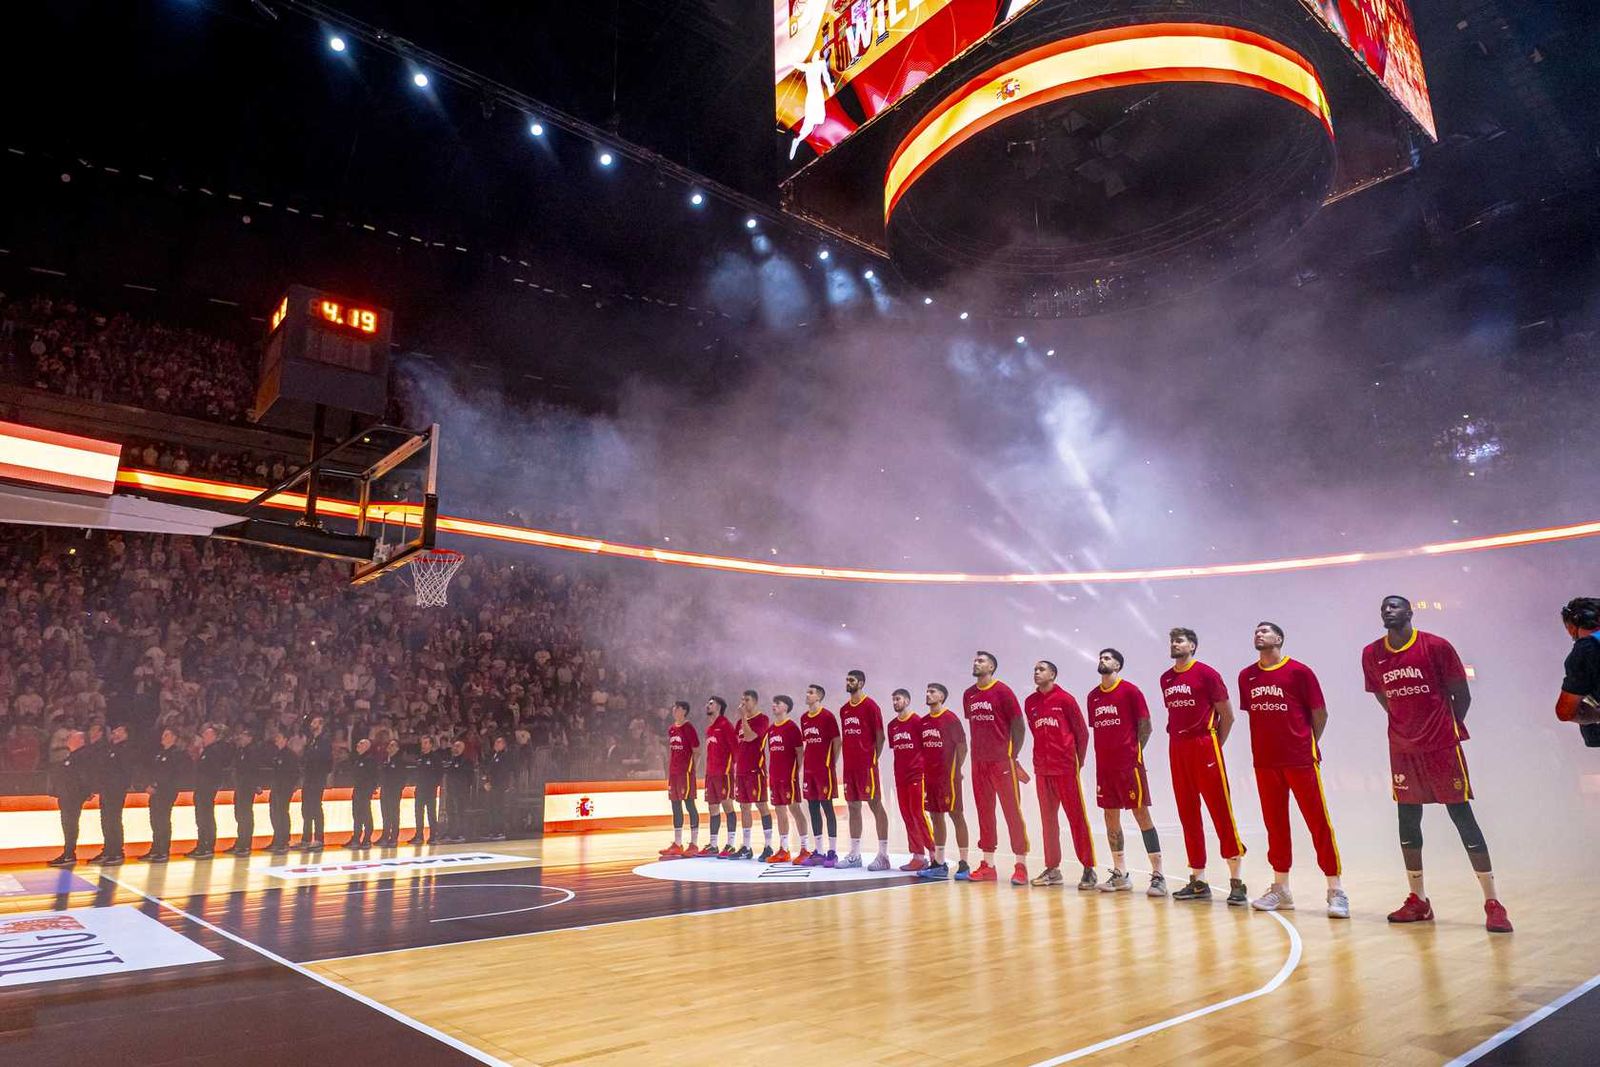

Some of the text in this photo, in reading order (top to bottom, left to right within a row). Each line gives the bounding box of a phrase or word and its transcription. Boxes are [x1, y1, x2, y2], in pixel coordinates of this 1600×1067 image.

[1382, 665, 1424, 684] ESPAÑA
[1164, 684, 1192, 698] ESPAÑA
[1250, 684, 1284, 699] ESPAÑA
[1385, 684, 1431, 698] endesa
[970, 700, 993, 712] ESPAÑA
[1166, 697, 1196, 708] ndesa
[1250, 701, 1288, 711] endesa
[1094, 704, 1118, 717] ESPAÑA
[1034, 716, 1059, 729] ESPAÑA
[1094, 718, 1121, 728] endesa
